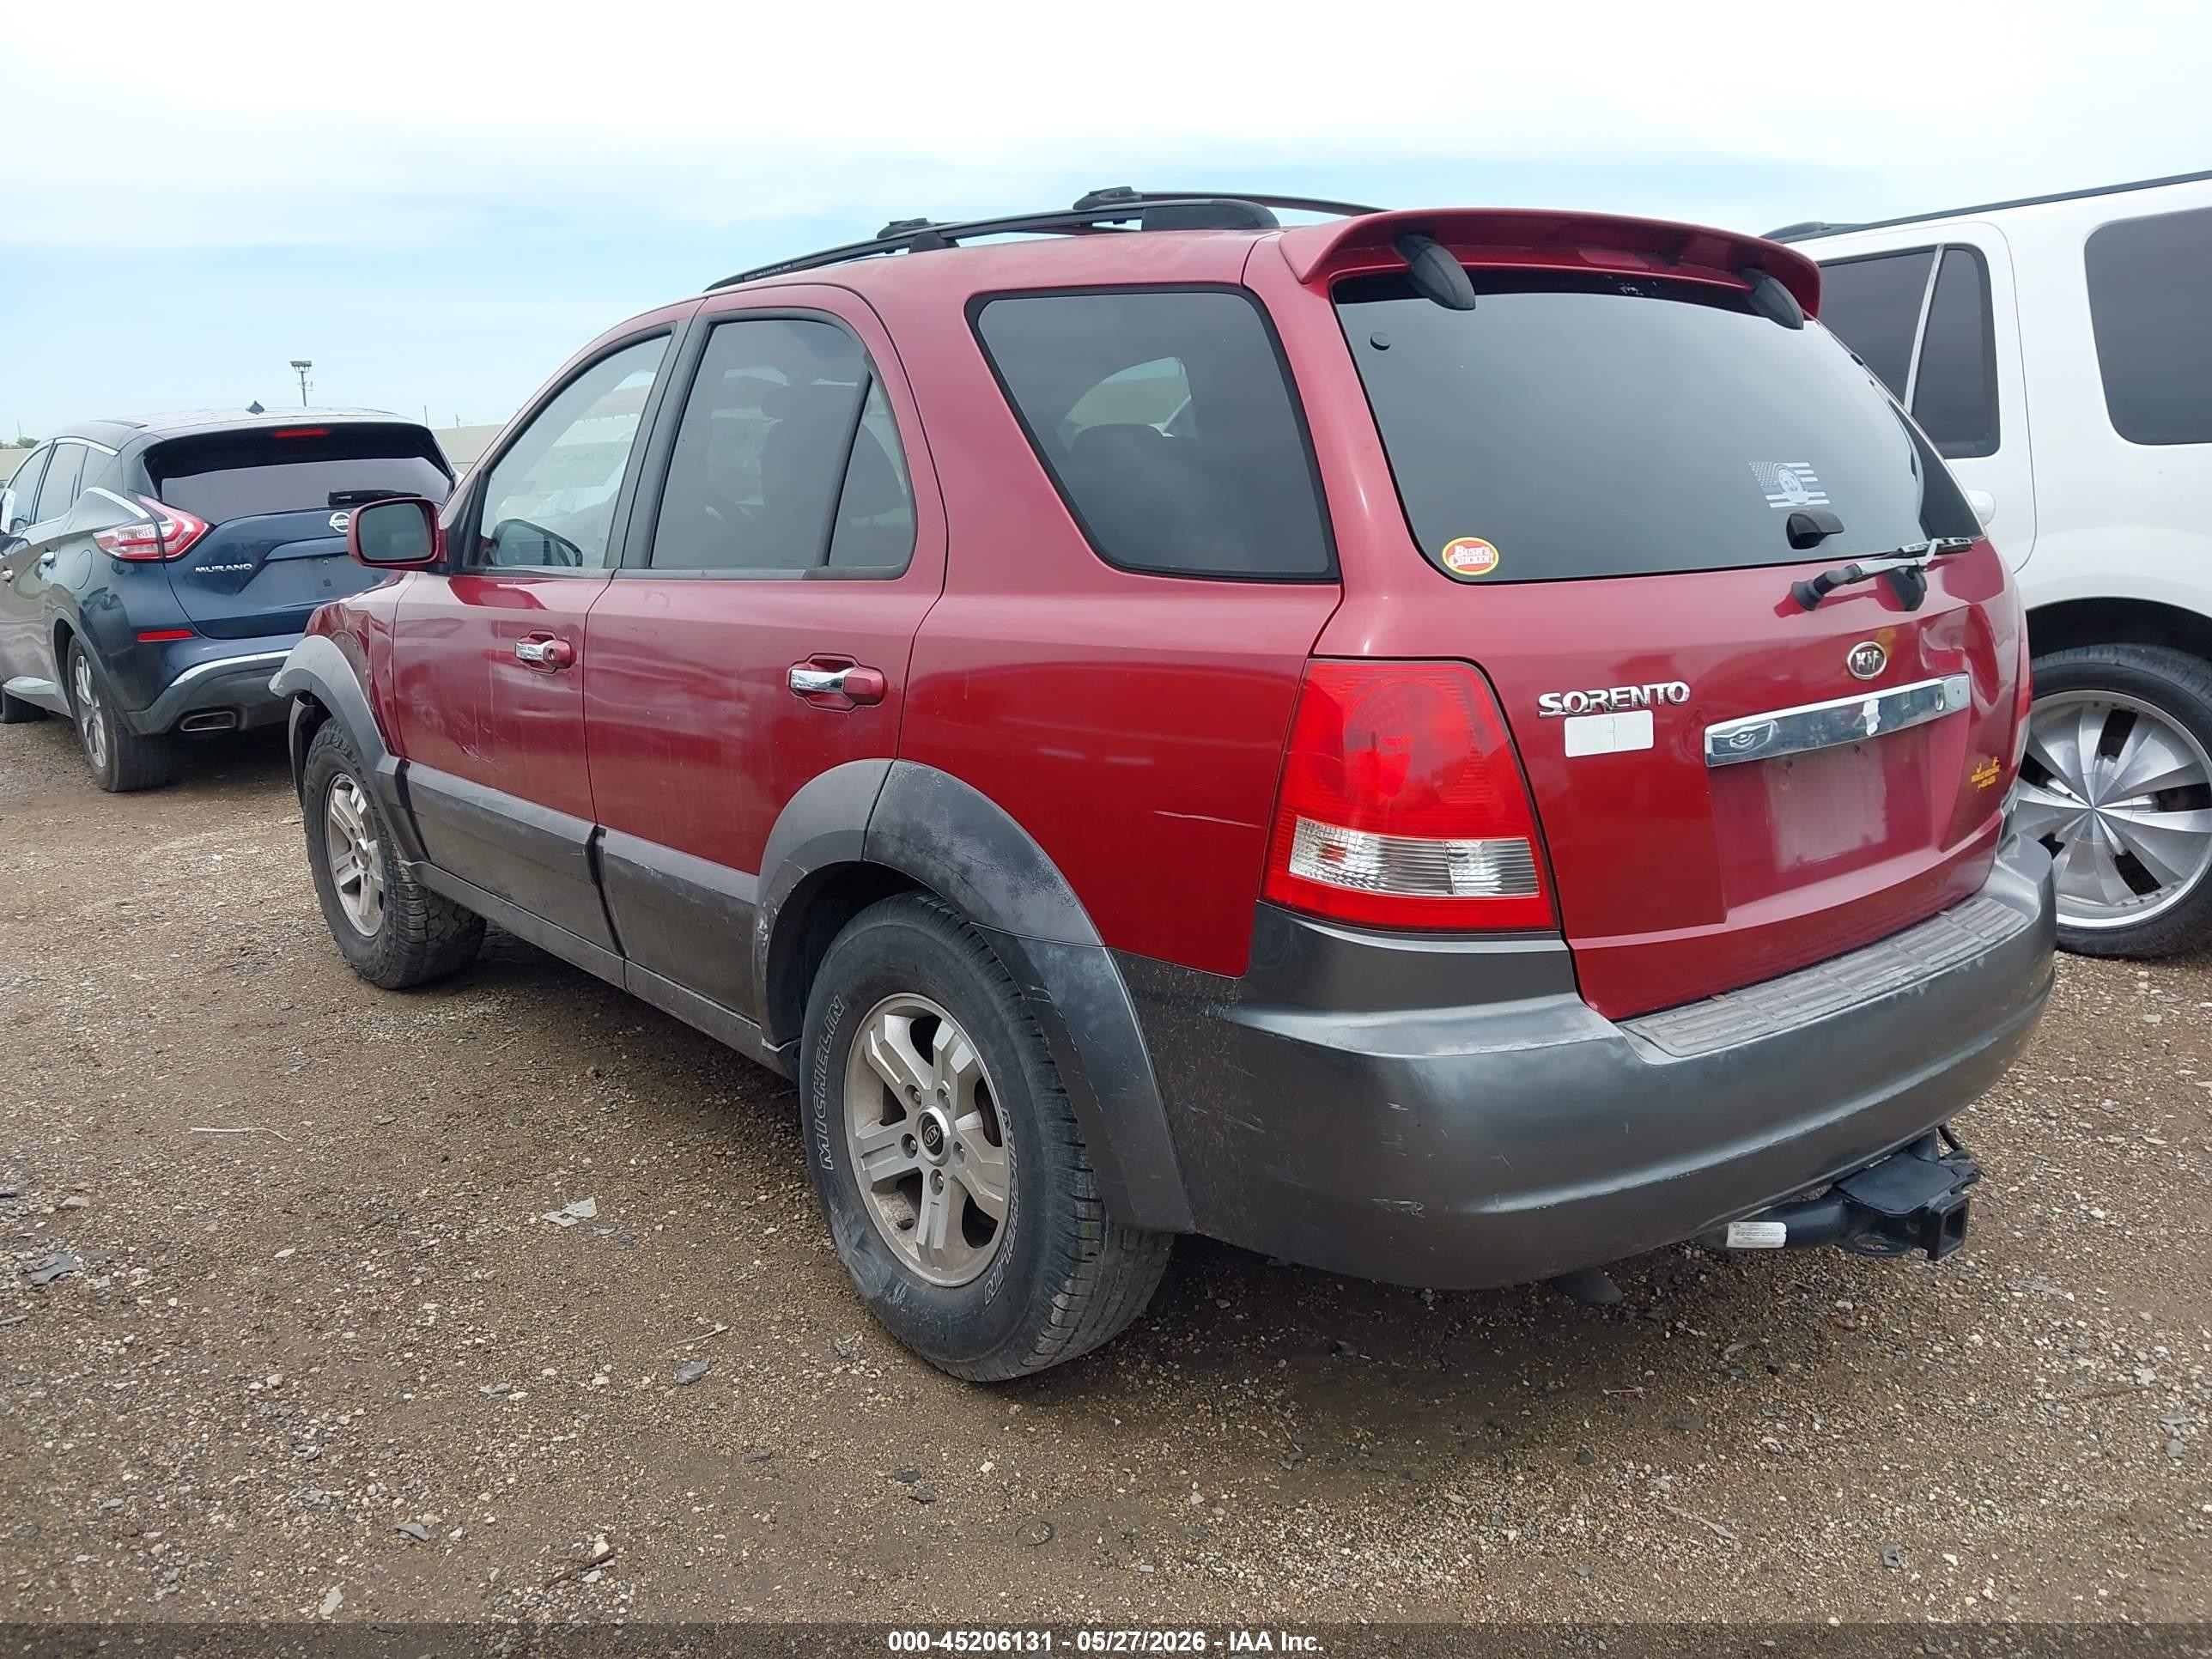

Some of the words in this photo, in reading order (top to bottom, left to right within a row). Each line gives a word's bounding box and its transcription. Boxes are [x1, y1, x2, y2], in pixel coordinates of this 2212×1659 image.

[195, 563, 252, 573] MURANO
[1538, 681, 1690, 718] SORENTO
[813, 994, 846, 1170] MICHELIN
[984, 1107, 1019, 1306] MICHELIN
